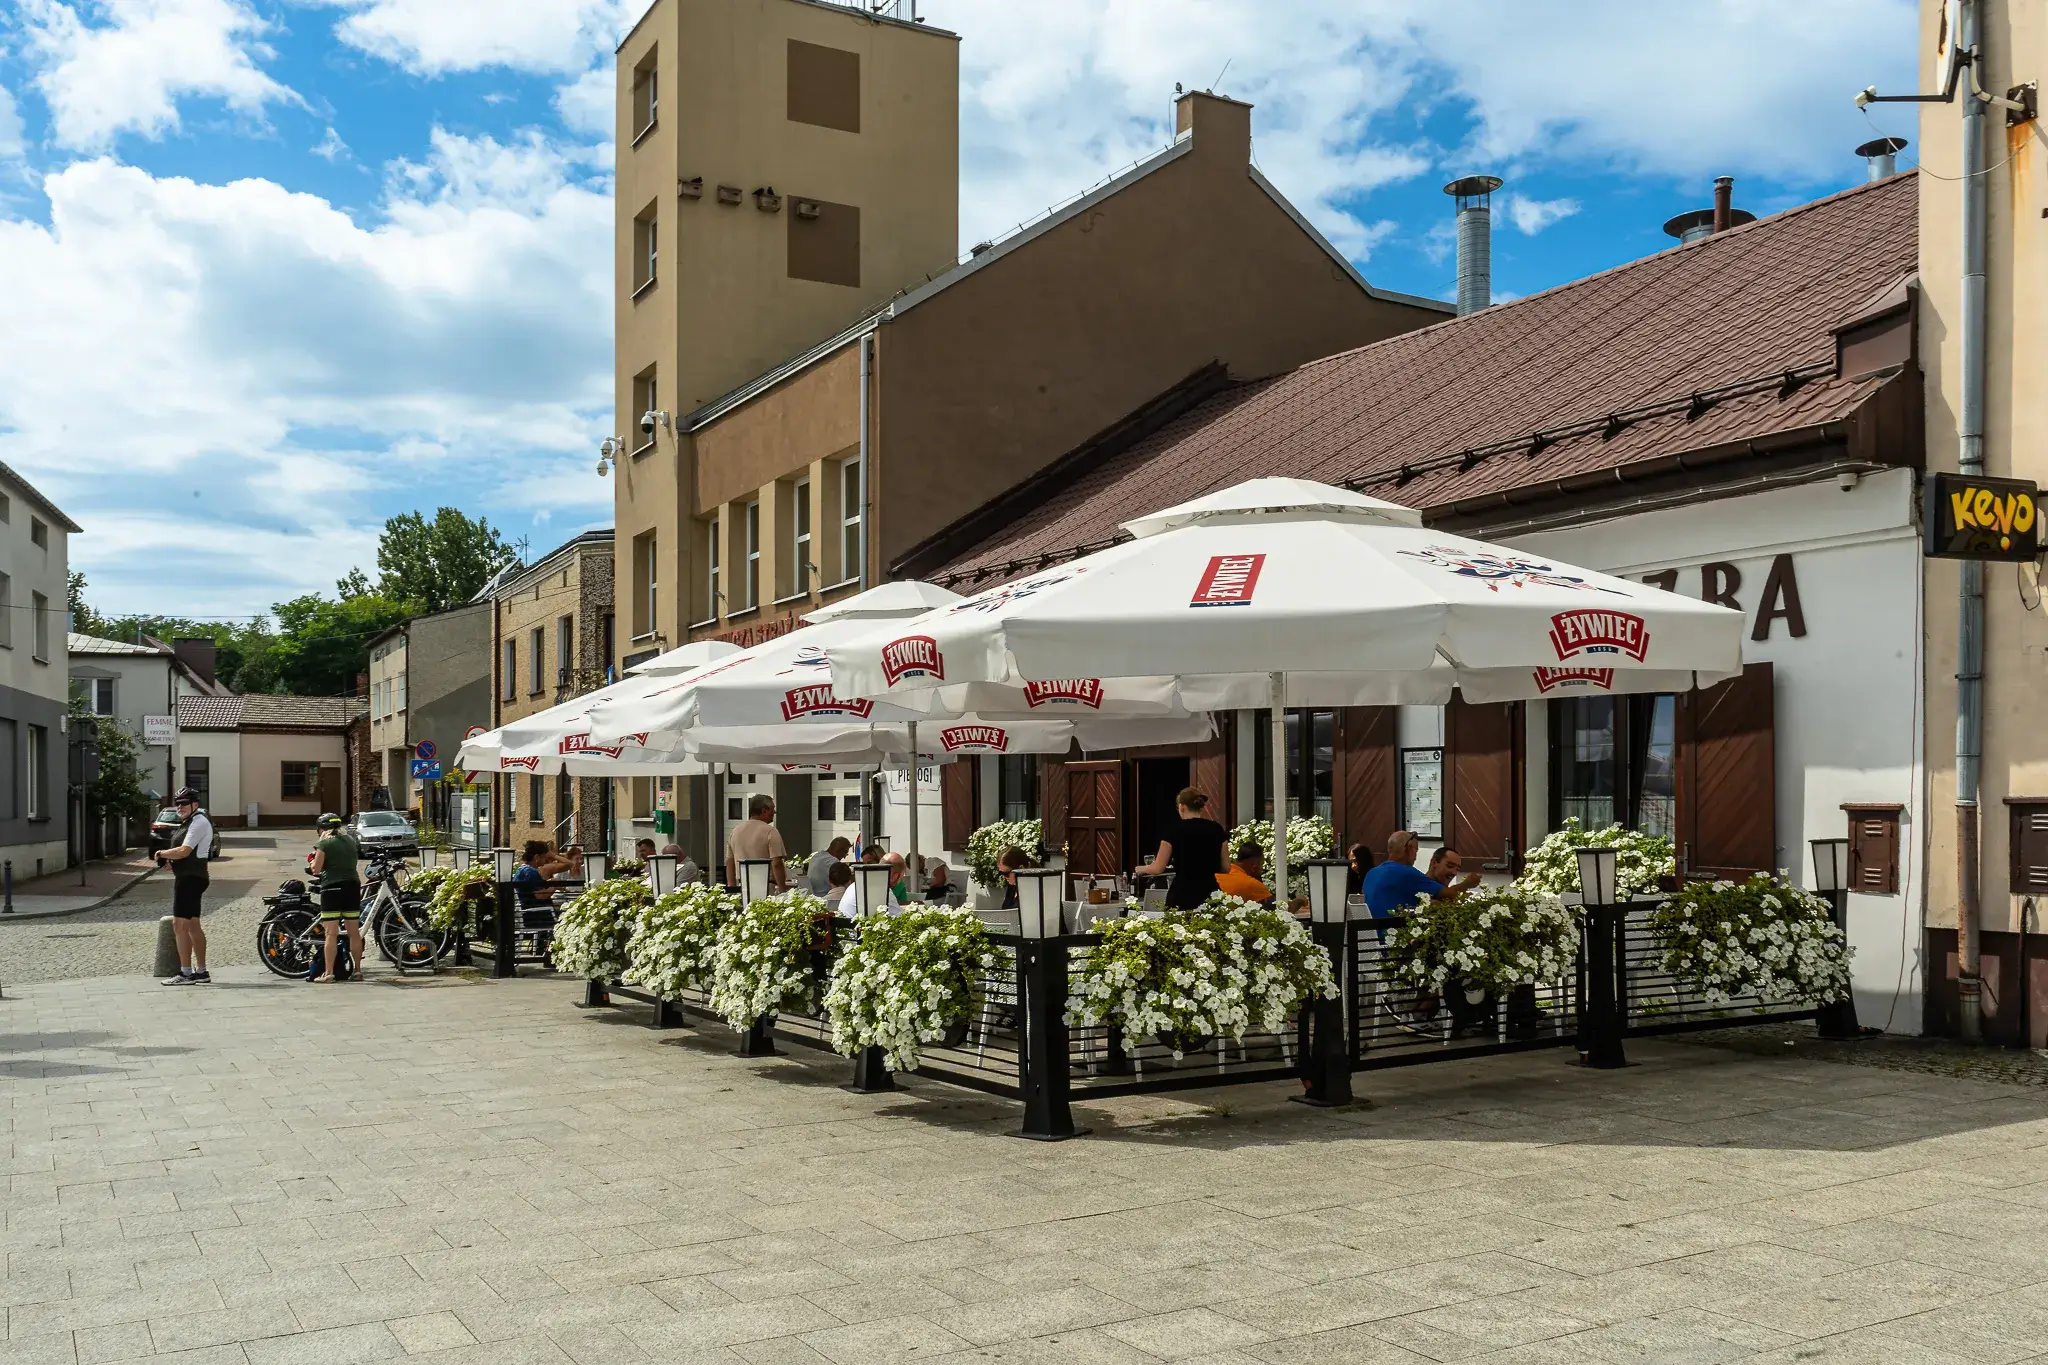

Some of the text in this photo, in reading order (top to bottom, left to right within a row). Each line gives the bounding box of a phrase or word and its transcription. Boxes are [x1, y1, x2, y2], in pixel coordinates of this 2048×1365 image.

[1200, 557, 1255, 599] ŻYWIEC
[1560, 613, 1638, 645] ŻYWIEC
[886, 640, 934, 671] ŻYWIEC
[146, 718, 174, 726] FEMME
[898, 767, 932, 783] PIEOGI
